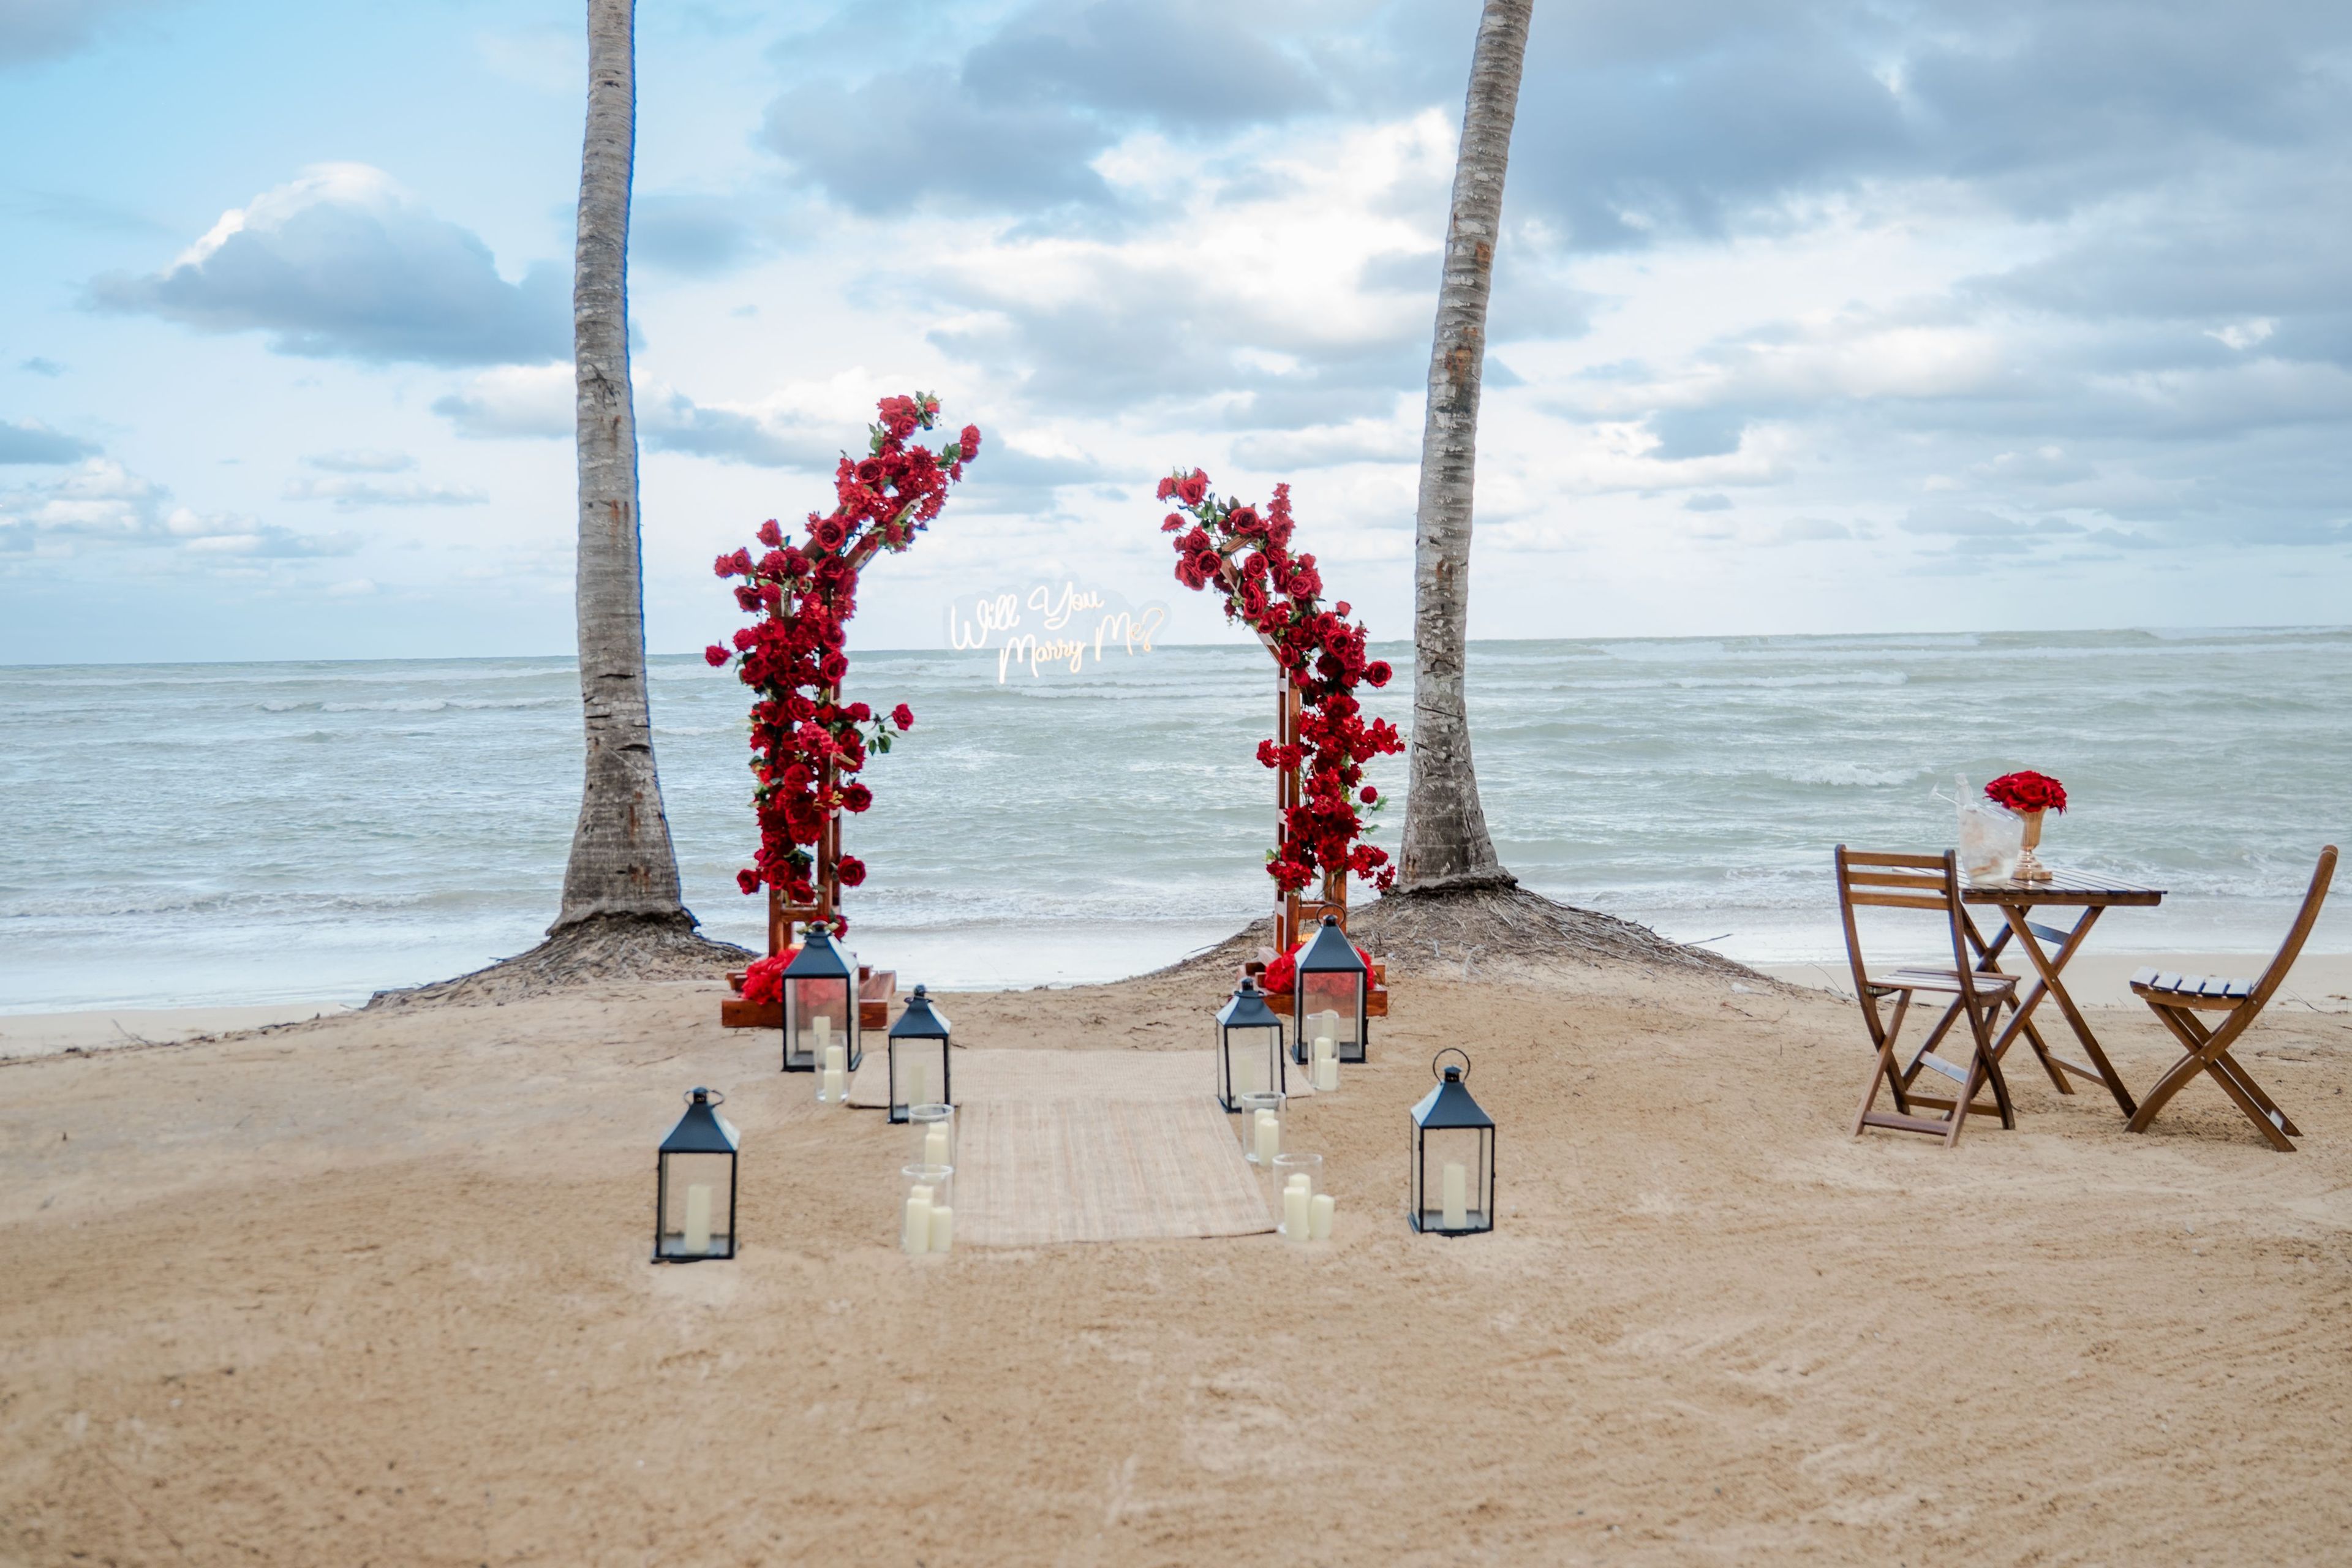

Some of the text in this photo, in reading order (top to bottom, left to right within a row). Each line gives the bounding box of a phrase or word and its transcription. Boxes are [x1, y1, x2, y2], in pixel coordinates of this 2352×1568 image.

[951, 581, 1105, 650] Will You
[998, 607, 1164, 684] Marry Me?
